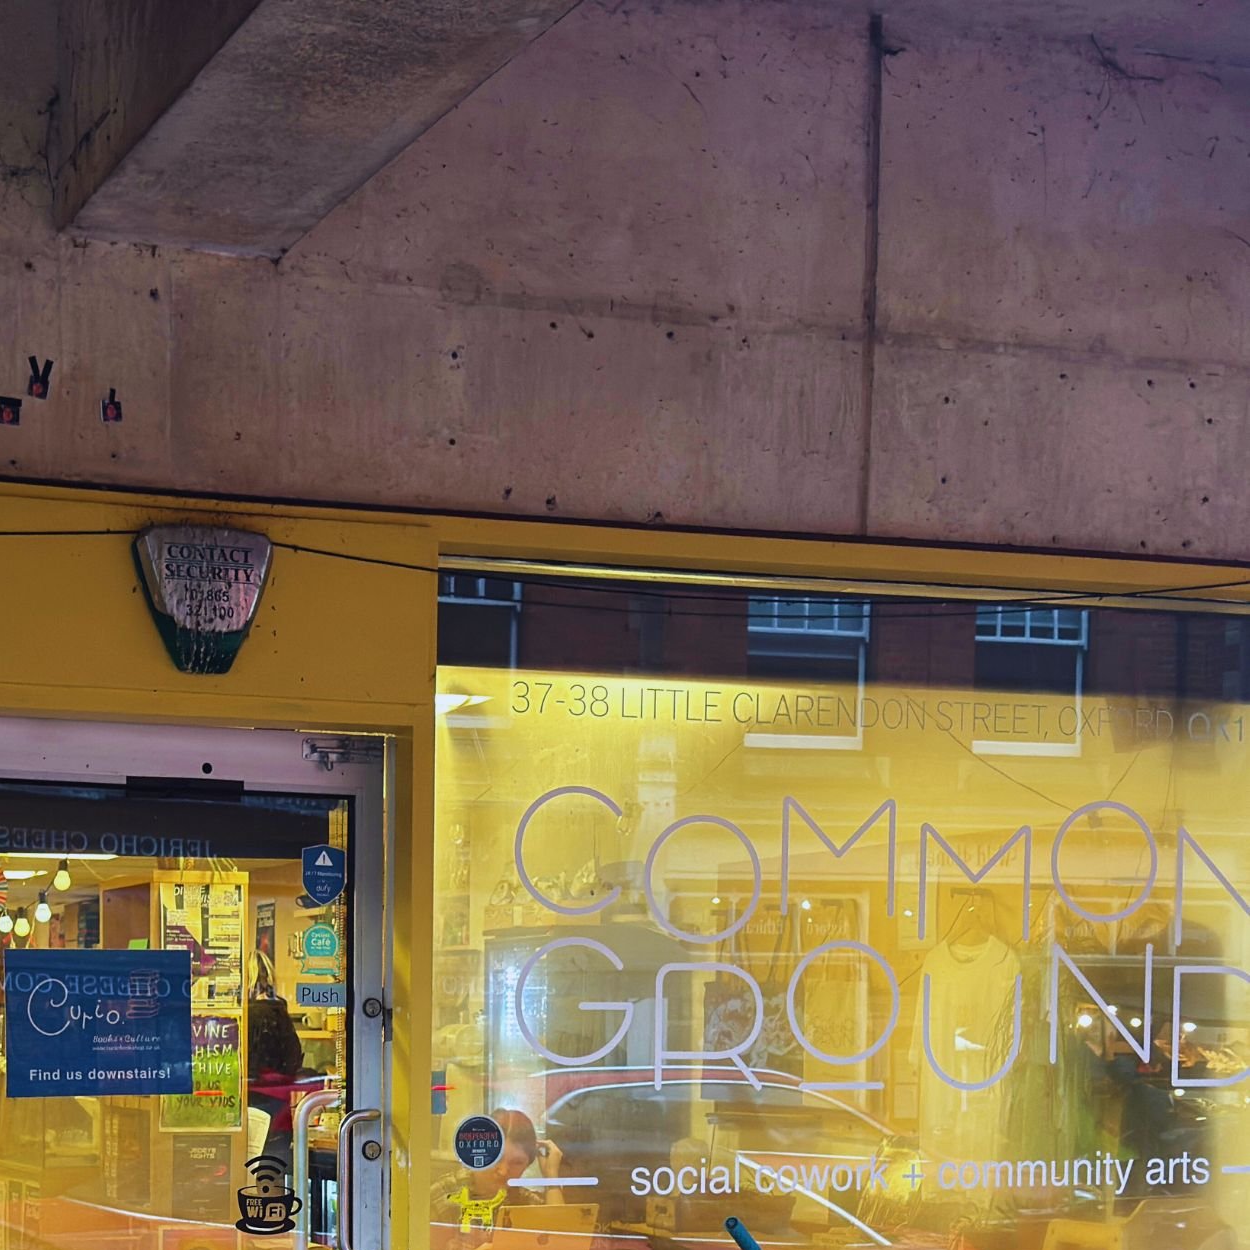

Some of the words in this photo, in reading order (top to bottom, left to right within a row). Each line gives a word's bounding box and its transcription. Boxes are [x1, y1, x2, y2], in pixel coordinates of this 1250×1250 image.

[167, 545, 252, 564] CONTACT
[165, 564, 254, 582] SECURITY
[511, 681, 609, 717] 37-38
[621, 687, 722, 723] LITTLE
[732, 692, 926, 731] CLARENDON
[936, 700, 1049, 740] STREET,
[514, 785, 1250, 944] COMMON
[302, 987, 338, 1003] Push
[514, 936, 1250, 1092] GROUND
[30, 1069, 60, 1081] Find
[67, 1071, 82, 1080] us
[88, 1068, 171, 1080] downstairs!
[459, 1140, 499, 1148] OXFORD
[630, 1155, 740, 1196] social
[755, 1156, 889, 1193] cowork
[938, 1151, 1135, 1195] community
[1145, 1151, 1211, 1185] arts
